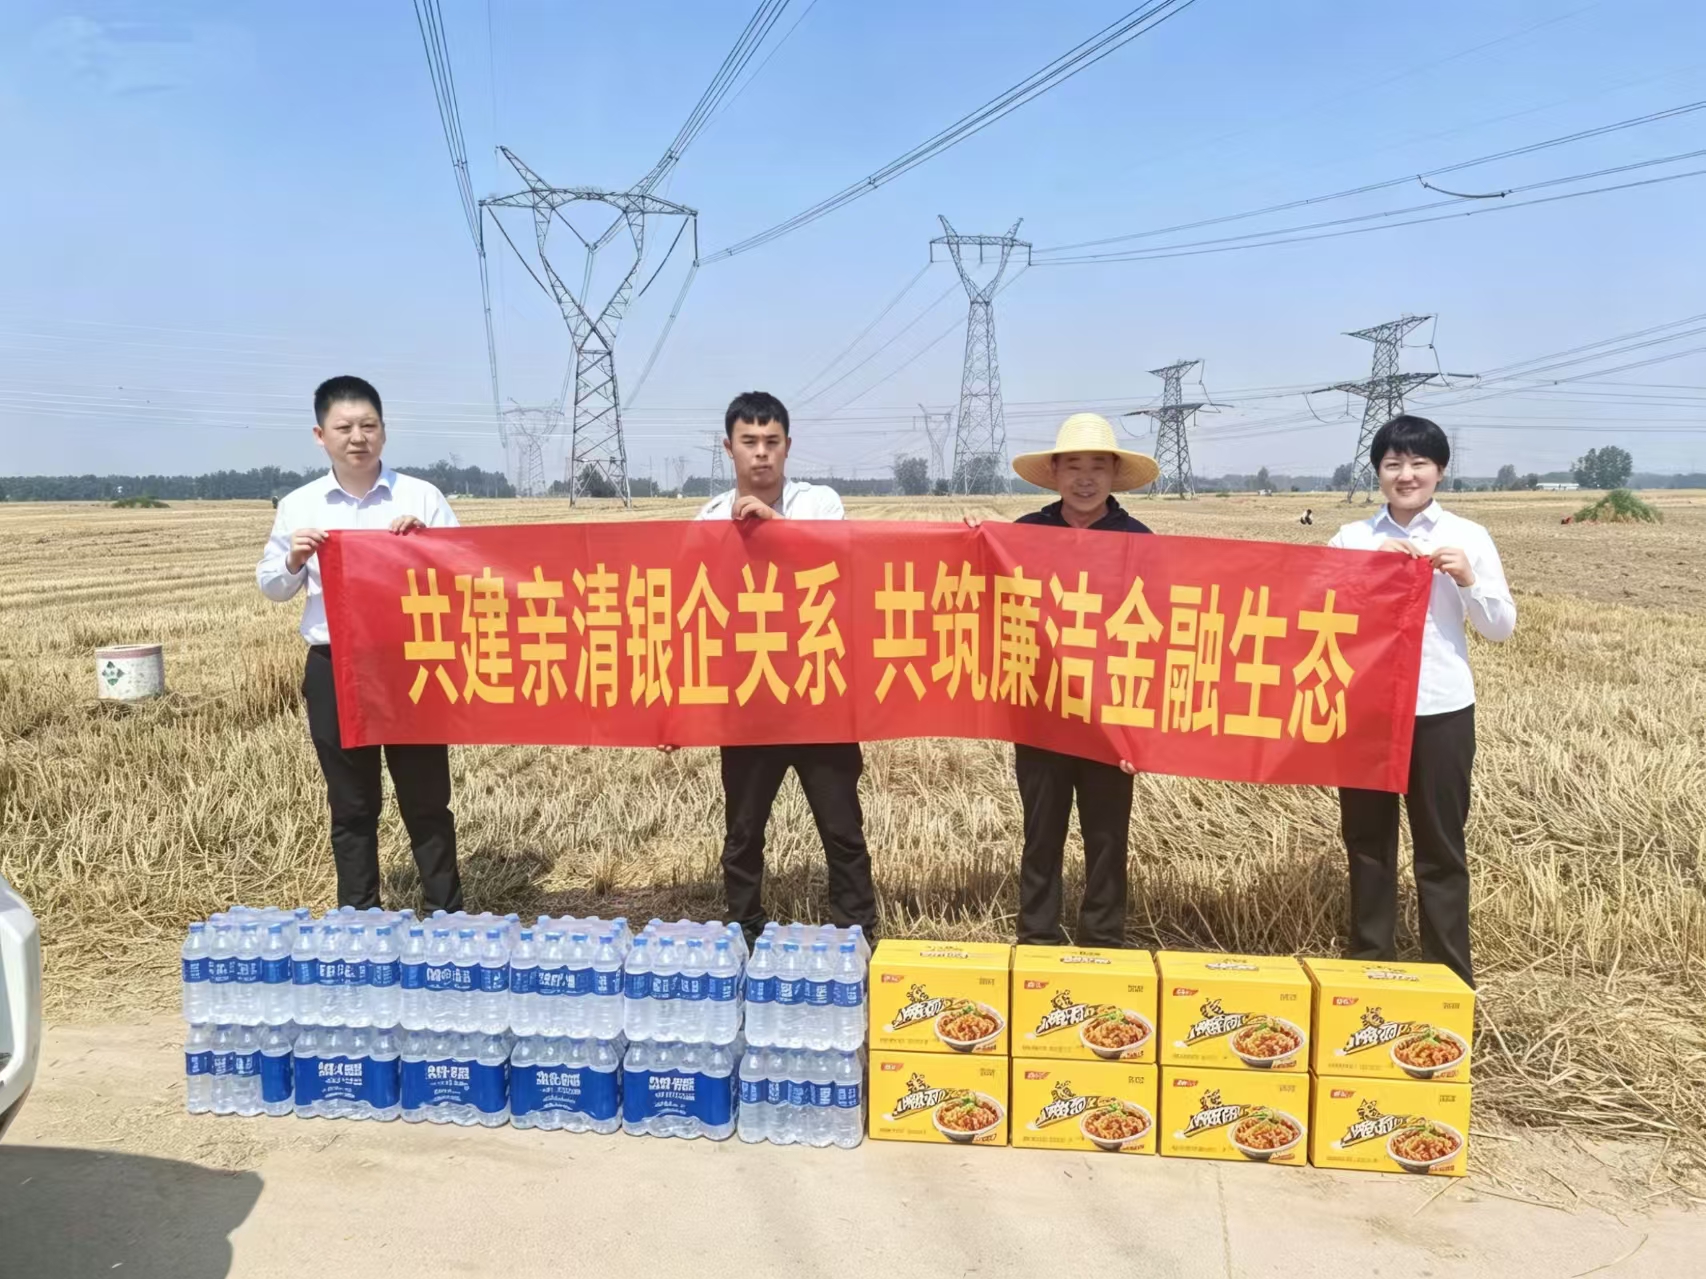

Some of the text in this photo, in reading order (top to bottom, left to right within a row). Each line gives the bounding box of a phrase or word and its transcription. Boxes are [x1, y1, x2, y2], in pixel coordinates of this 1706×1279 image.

[401, 560, 1359, 744] 共建亲清银企关系 共筑廉洁金融生态
